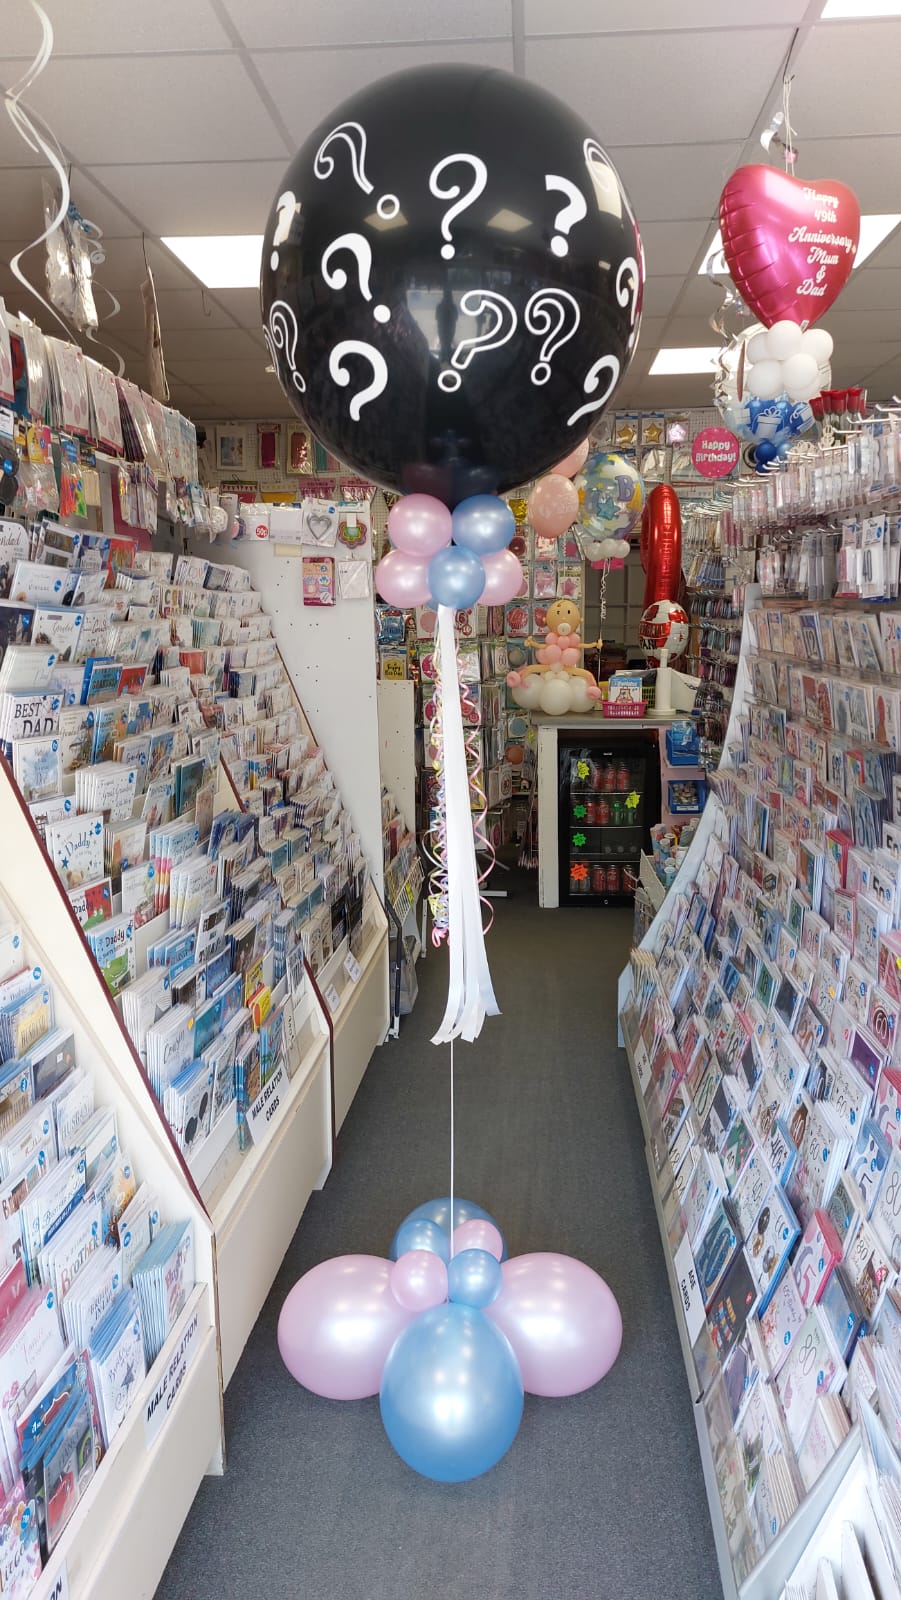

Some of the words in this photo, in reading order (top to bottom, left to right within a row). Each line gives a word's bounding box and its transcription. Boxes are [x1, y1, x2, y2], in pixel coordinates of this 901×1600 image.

[803, 187, 839, 209] Happy
[815, 210, 837, 223] 49th
[807, 246, 839, 265] Mum
[816, 265, 826, 282] &
[797, 280, 826, 297] Dad
[701, 440, 730, 452] Happy
[696, 451, 736, 463] Birthday!
[15, 702, 42, 719] BEST
[23, 717, 54, 736] DAD
[65, 832, 91, 857] Daddy
[73, 899, 94, 913] Daddy
[105, 928, 125, 947] Daddy
[252, 1096, 265, 1121] MALE
[264, 1068, 283, 1102] RELATION
[266, 1095, 280, 1121] CARDS
[856, 1240, 869, 1260] 80
[688, 1269, 696, 1290] AGE
[681, 1279, 691, 1311] CARDS
[800, 1334, 817, 1377] 80
[147, 1375, 168, 1422] MALE
[169, 1313, 198, 1379] RELATION
[166, 1361, 186, 1411] CARDS
